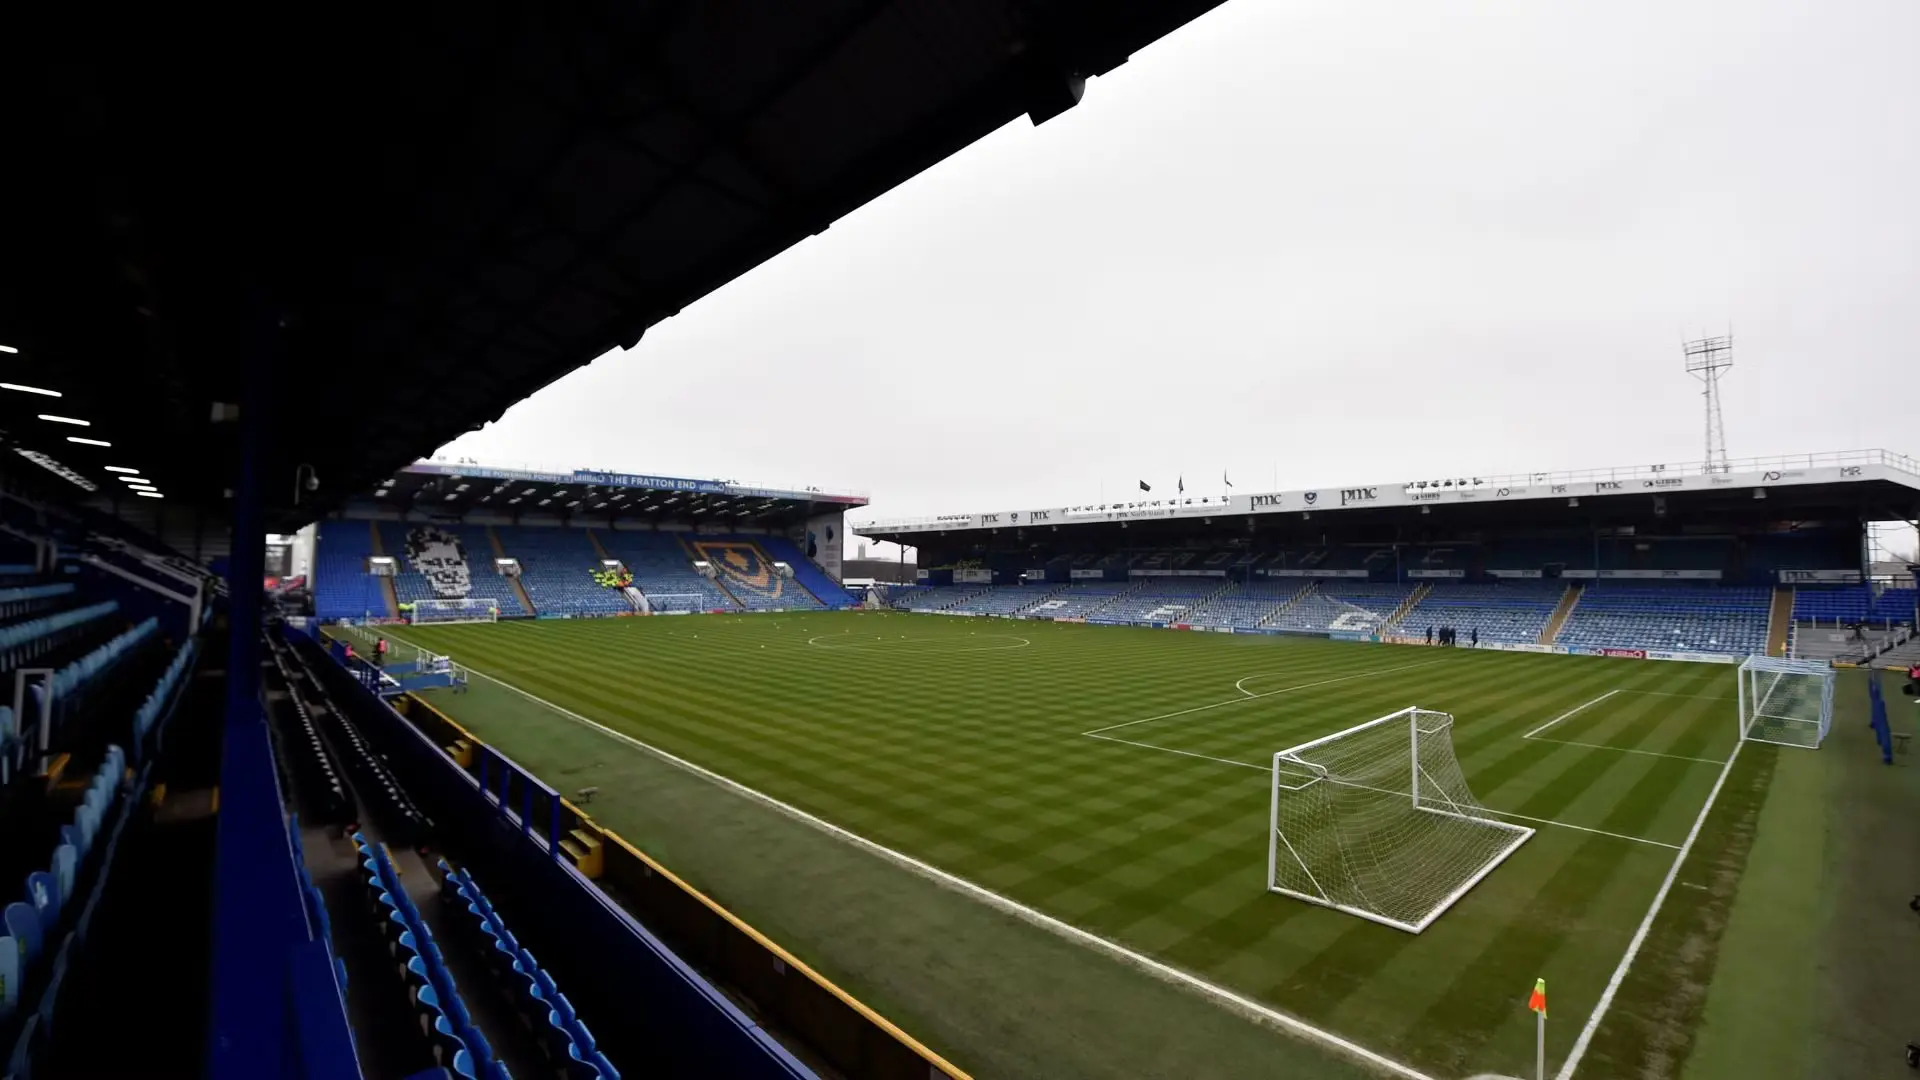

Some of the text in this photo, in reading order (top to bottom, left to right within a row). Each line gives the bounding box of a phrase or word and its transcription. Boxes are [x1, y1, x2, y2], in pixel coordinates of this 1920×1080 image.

[609, 475, 697, 490] THE FRATTON END
[1596, 481, 1622, 493] pmc
[1250, 494, 1282, 511] pmc
[1340, 487, 1377, 506] pmc
[981, 513, 999, 526] pmc
[1030, 510, 1050, 524] pmc
[1785, 571, 1819, 582] pmc
